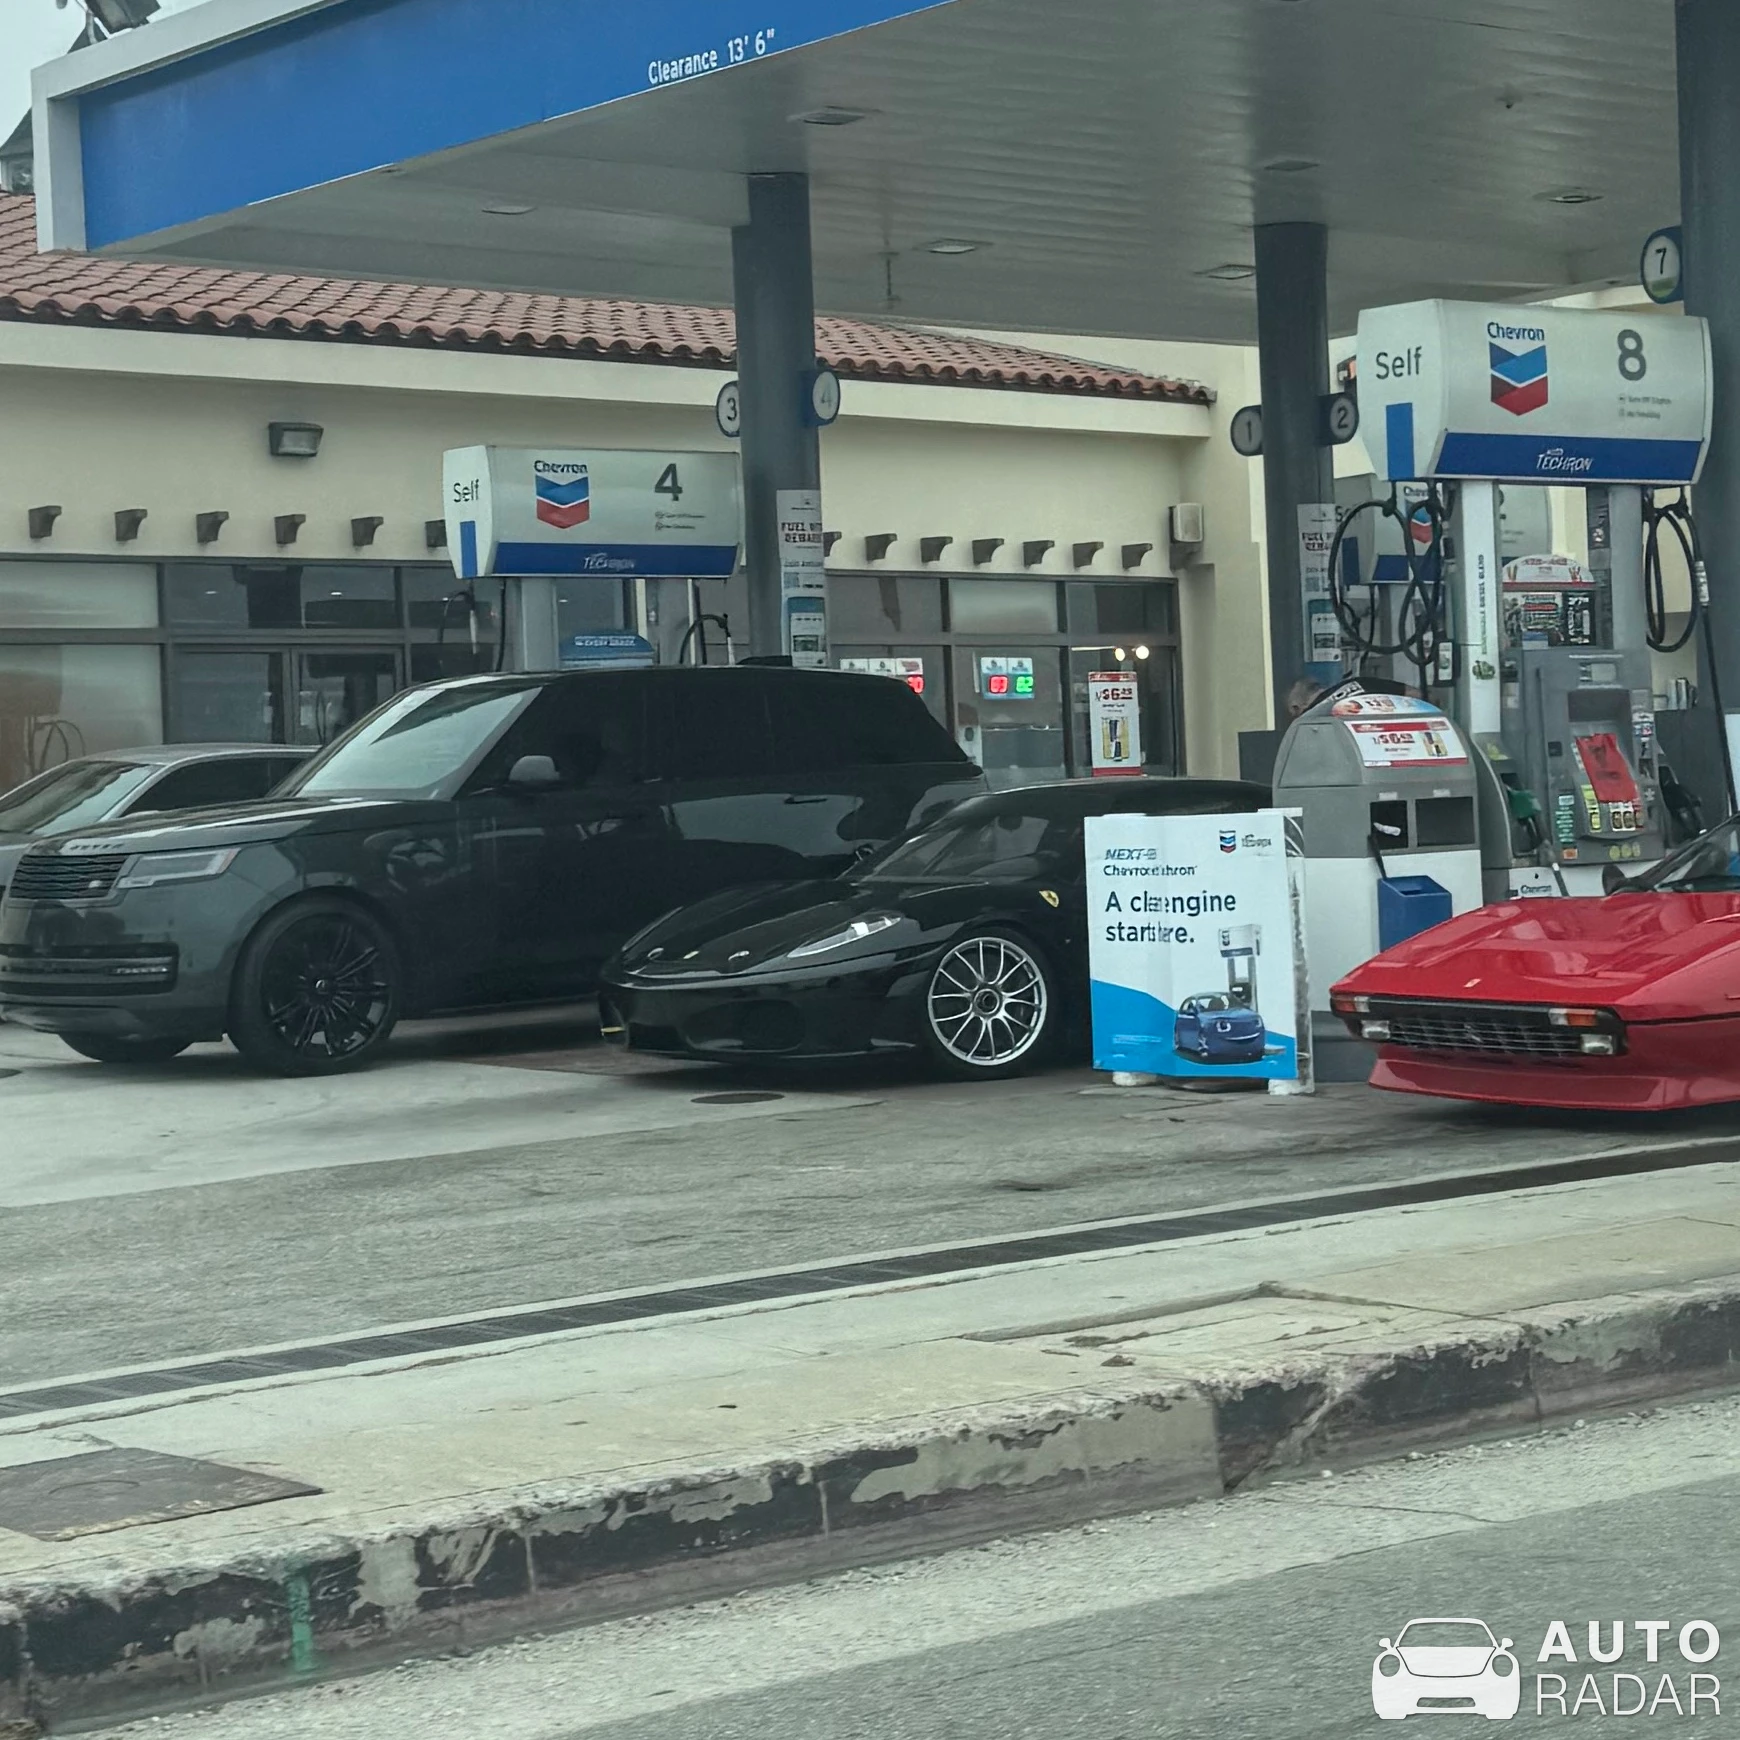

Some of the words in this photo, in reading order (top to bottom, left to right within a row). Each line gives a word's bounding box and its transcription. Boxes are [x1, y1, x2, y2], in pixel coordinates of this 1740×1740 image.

[648, 50, 718, 84] Clearance
[728, 35, 749, 62] 13'
[755, 28, 775, 55] 6"
[1655, 248, 1667, 275] 7
[1487, 321, 1546, 341] Chevron
[1375, 346, 1422, 379] Self
[1617, 328, 1647, 381] 8
[727, 397, 737, 421] 3
[1337, 405, 1349, 429] 2
[453, 479, 479, 503] Self
[654, 463, 683, 501] 4
[1105, 891, 1122, 912] A
